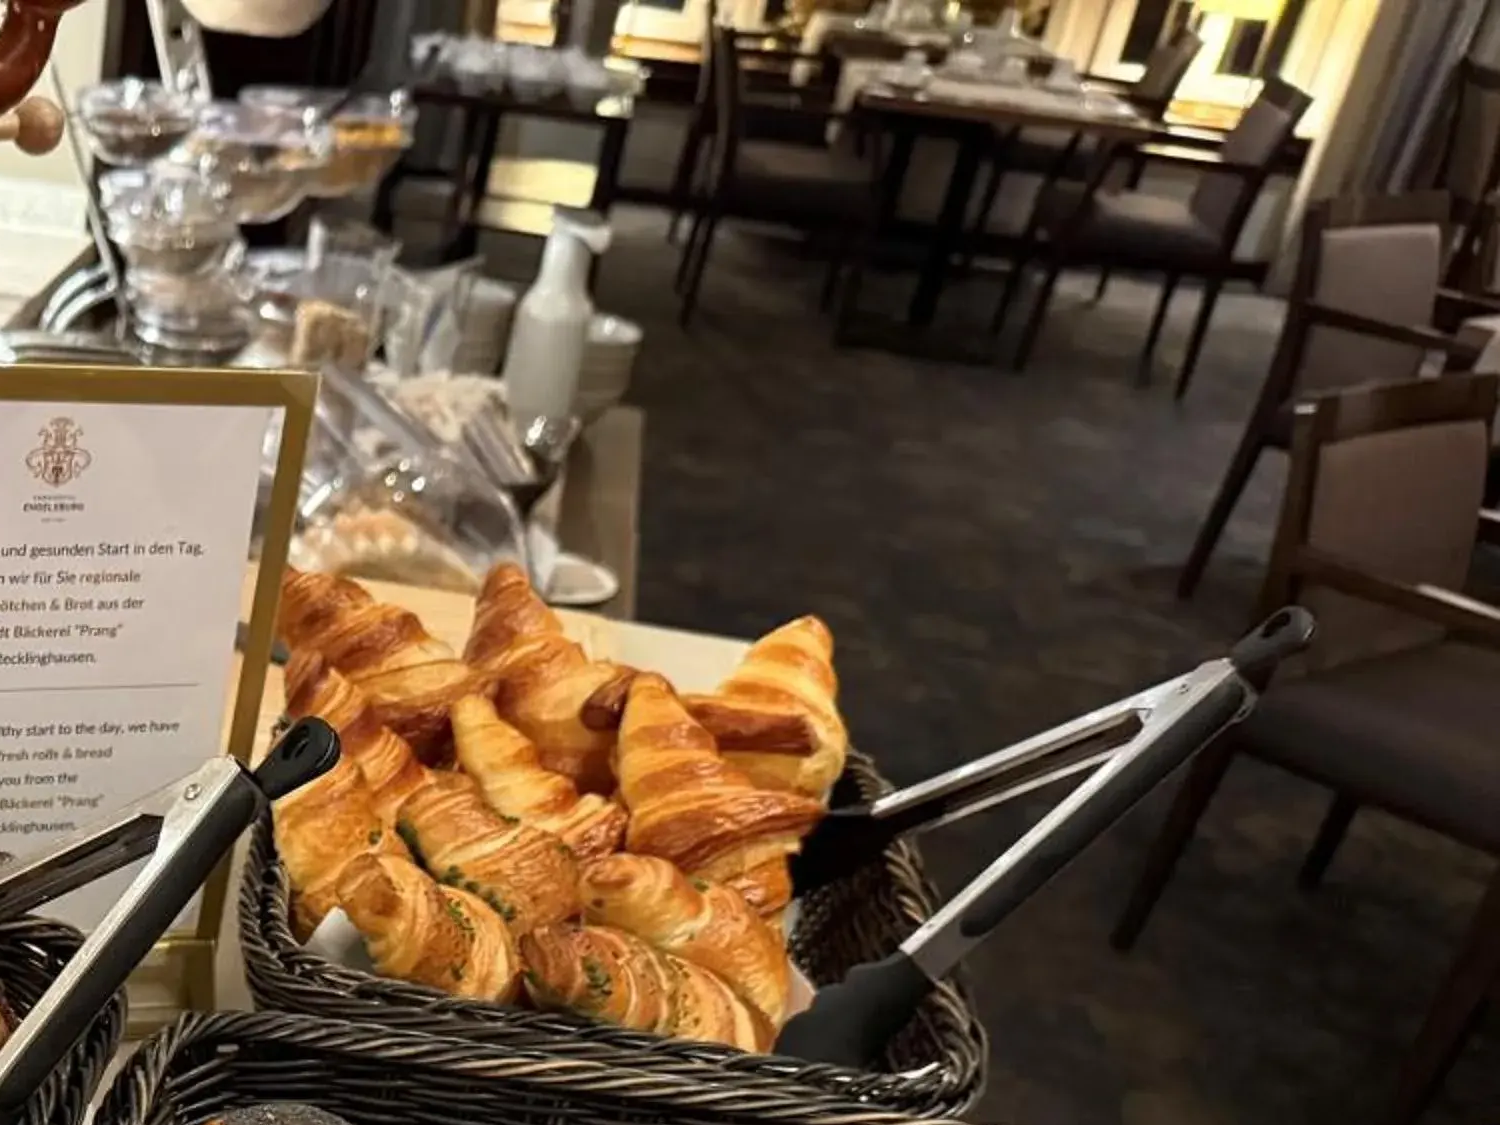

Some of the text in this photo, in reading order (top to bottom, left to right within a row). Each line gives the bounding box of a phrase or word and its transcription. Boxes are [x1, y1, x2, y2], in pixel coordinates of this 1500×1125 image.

[1, 544, 27, 557] und
[29, 543, 94, 560] gesunden
[98, 542, 129, 556] Start
[133, 543, 145, 556] in
[149, 541, 173, 555] den
[8, 571, 30, 585] wir
[33, 571, 53, 585] für
[56, 570, 76, 584] Sie
[79, 569, 141, 585] regionale
[49, 598, 60, 611] &
[64, 597, 93, 611] Brot
[97, 599, 119, 611] aus
[122, 597, 146, 610] der
[13, 624, 71, 639] Bäckerei
[26, 724, 56, 737] start
[58, 723, 73, 736] to
[75, 722, 96, 735] the
[128, 721, 147, 733] we
[150, 720, 180, 733] have
[32, 747, 59, 761] rolls
[62, 747, 73, 760] &
[75, 746, 113, 760] bread
[24, 773, 55, 786] from
